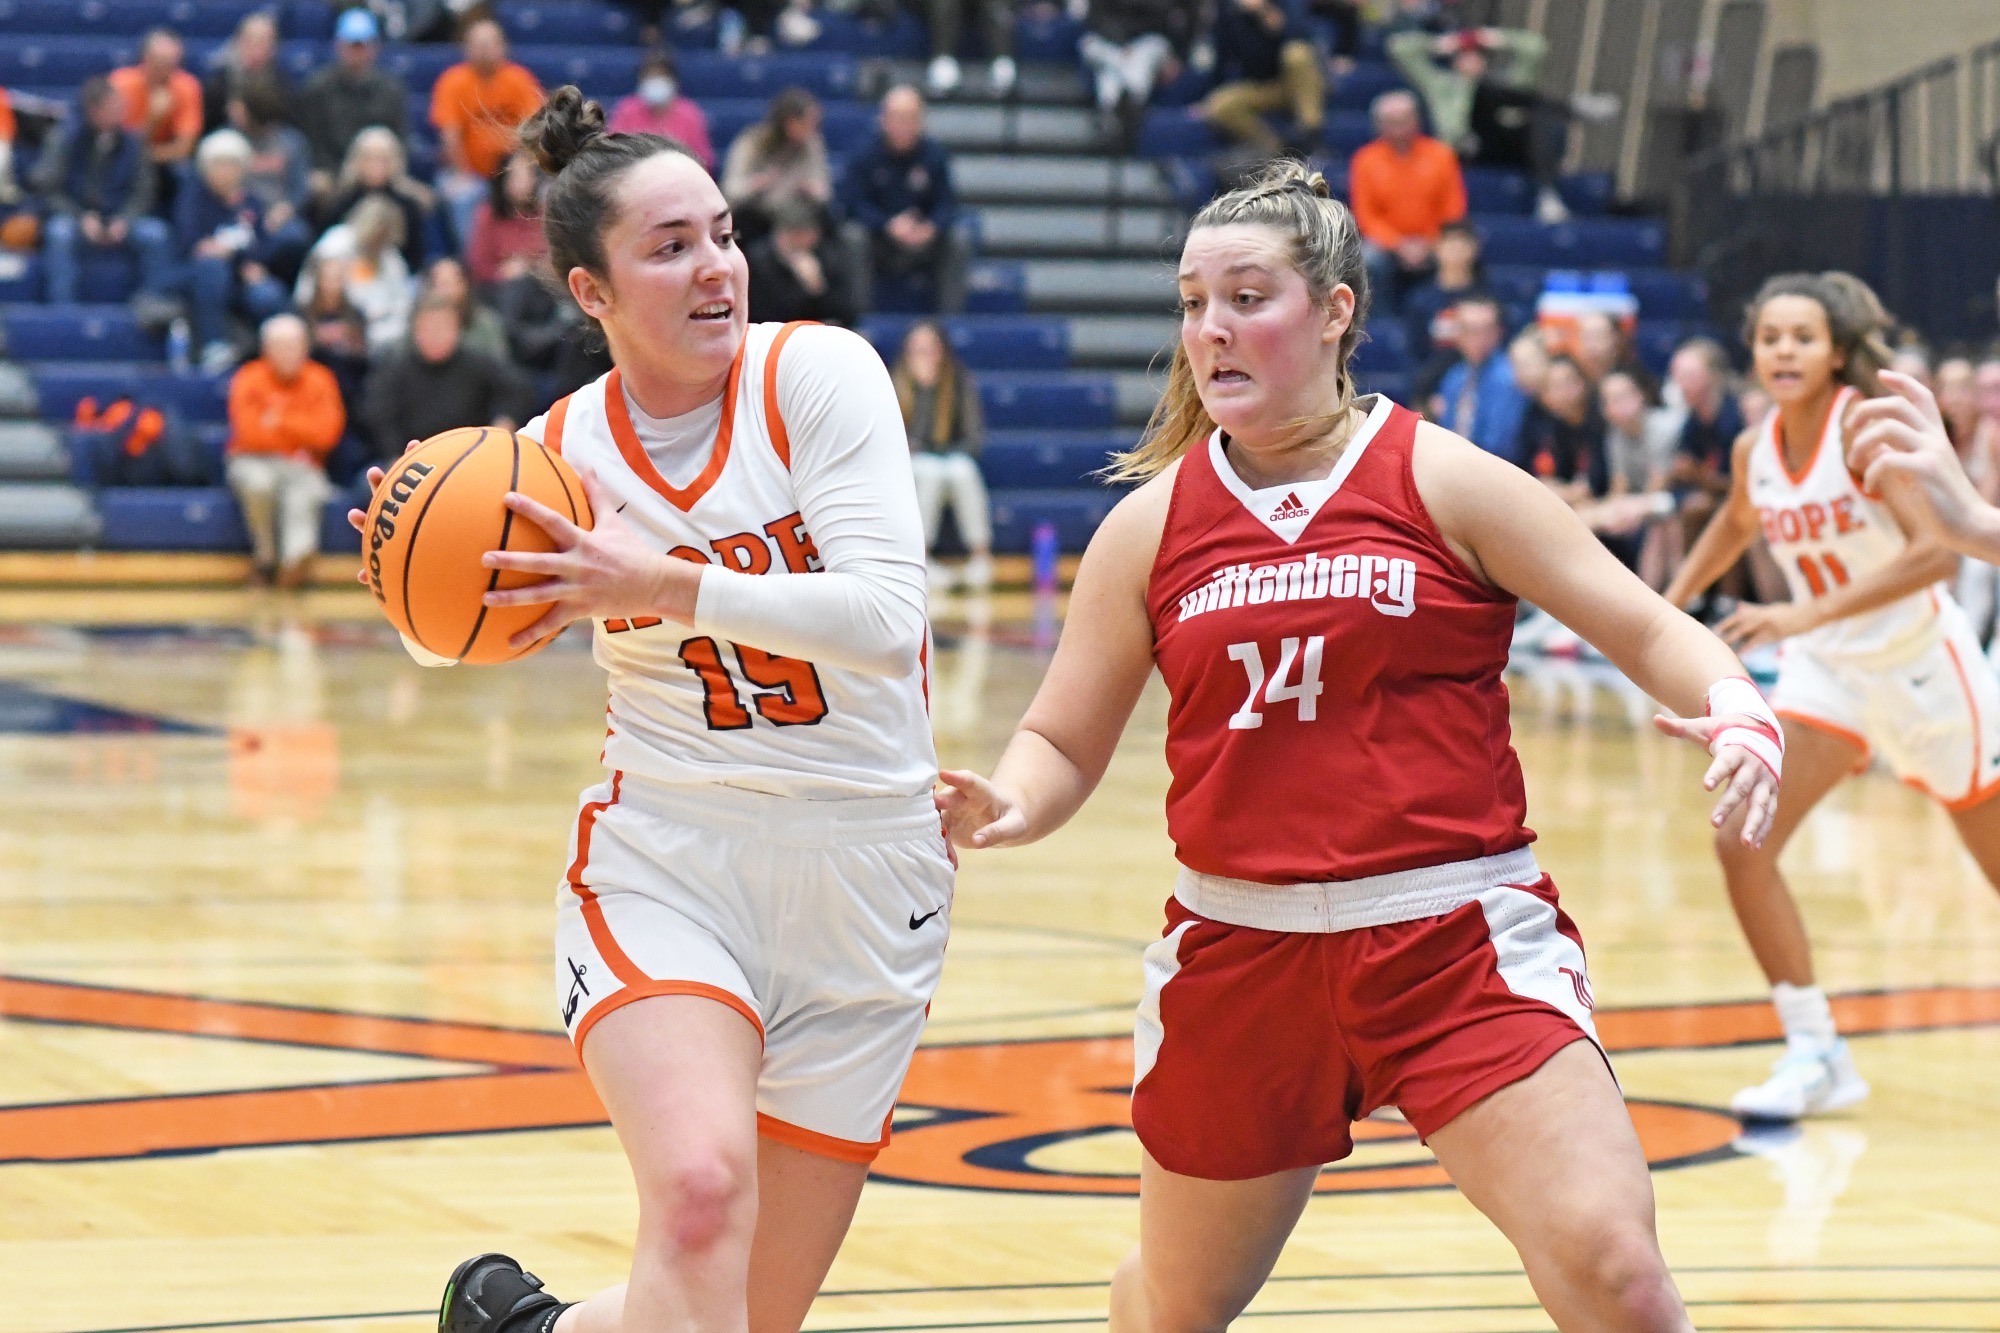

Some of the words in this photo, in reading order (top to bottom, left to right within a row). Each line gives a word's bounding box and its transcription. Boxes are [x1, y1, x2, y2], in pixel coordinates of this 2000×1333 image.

[1270, 508, 1310, 522] adidas
[1797, 553, 1850, 599] 11
[677, 635, 829, 731] 15
[1227, 635, 1325, 730] 14
